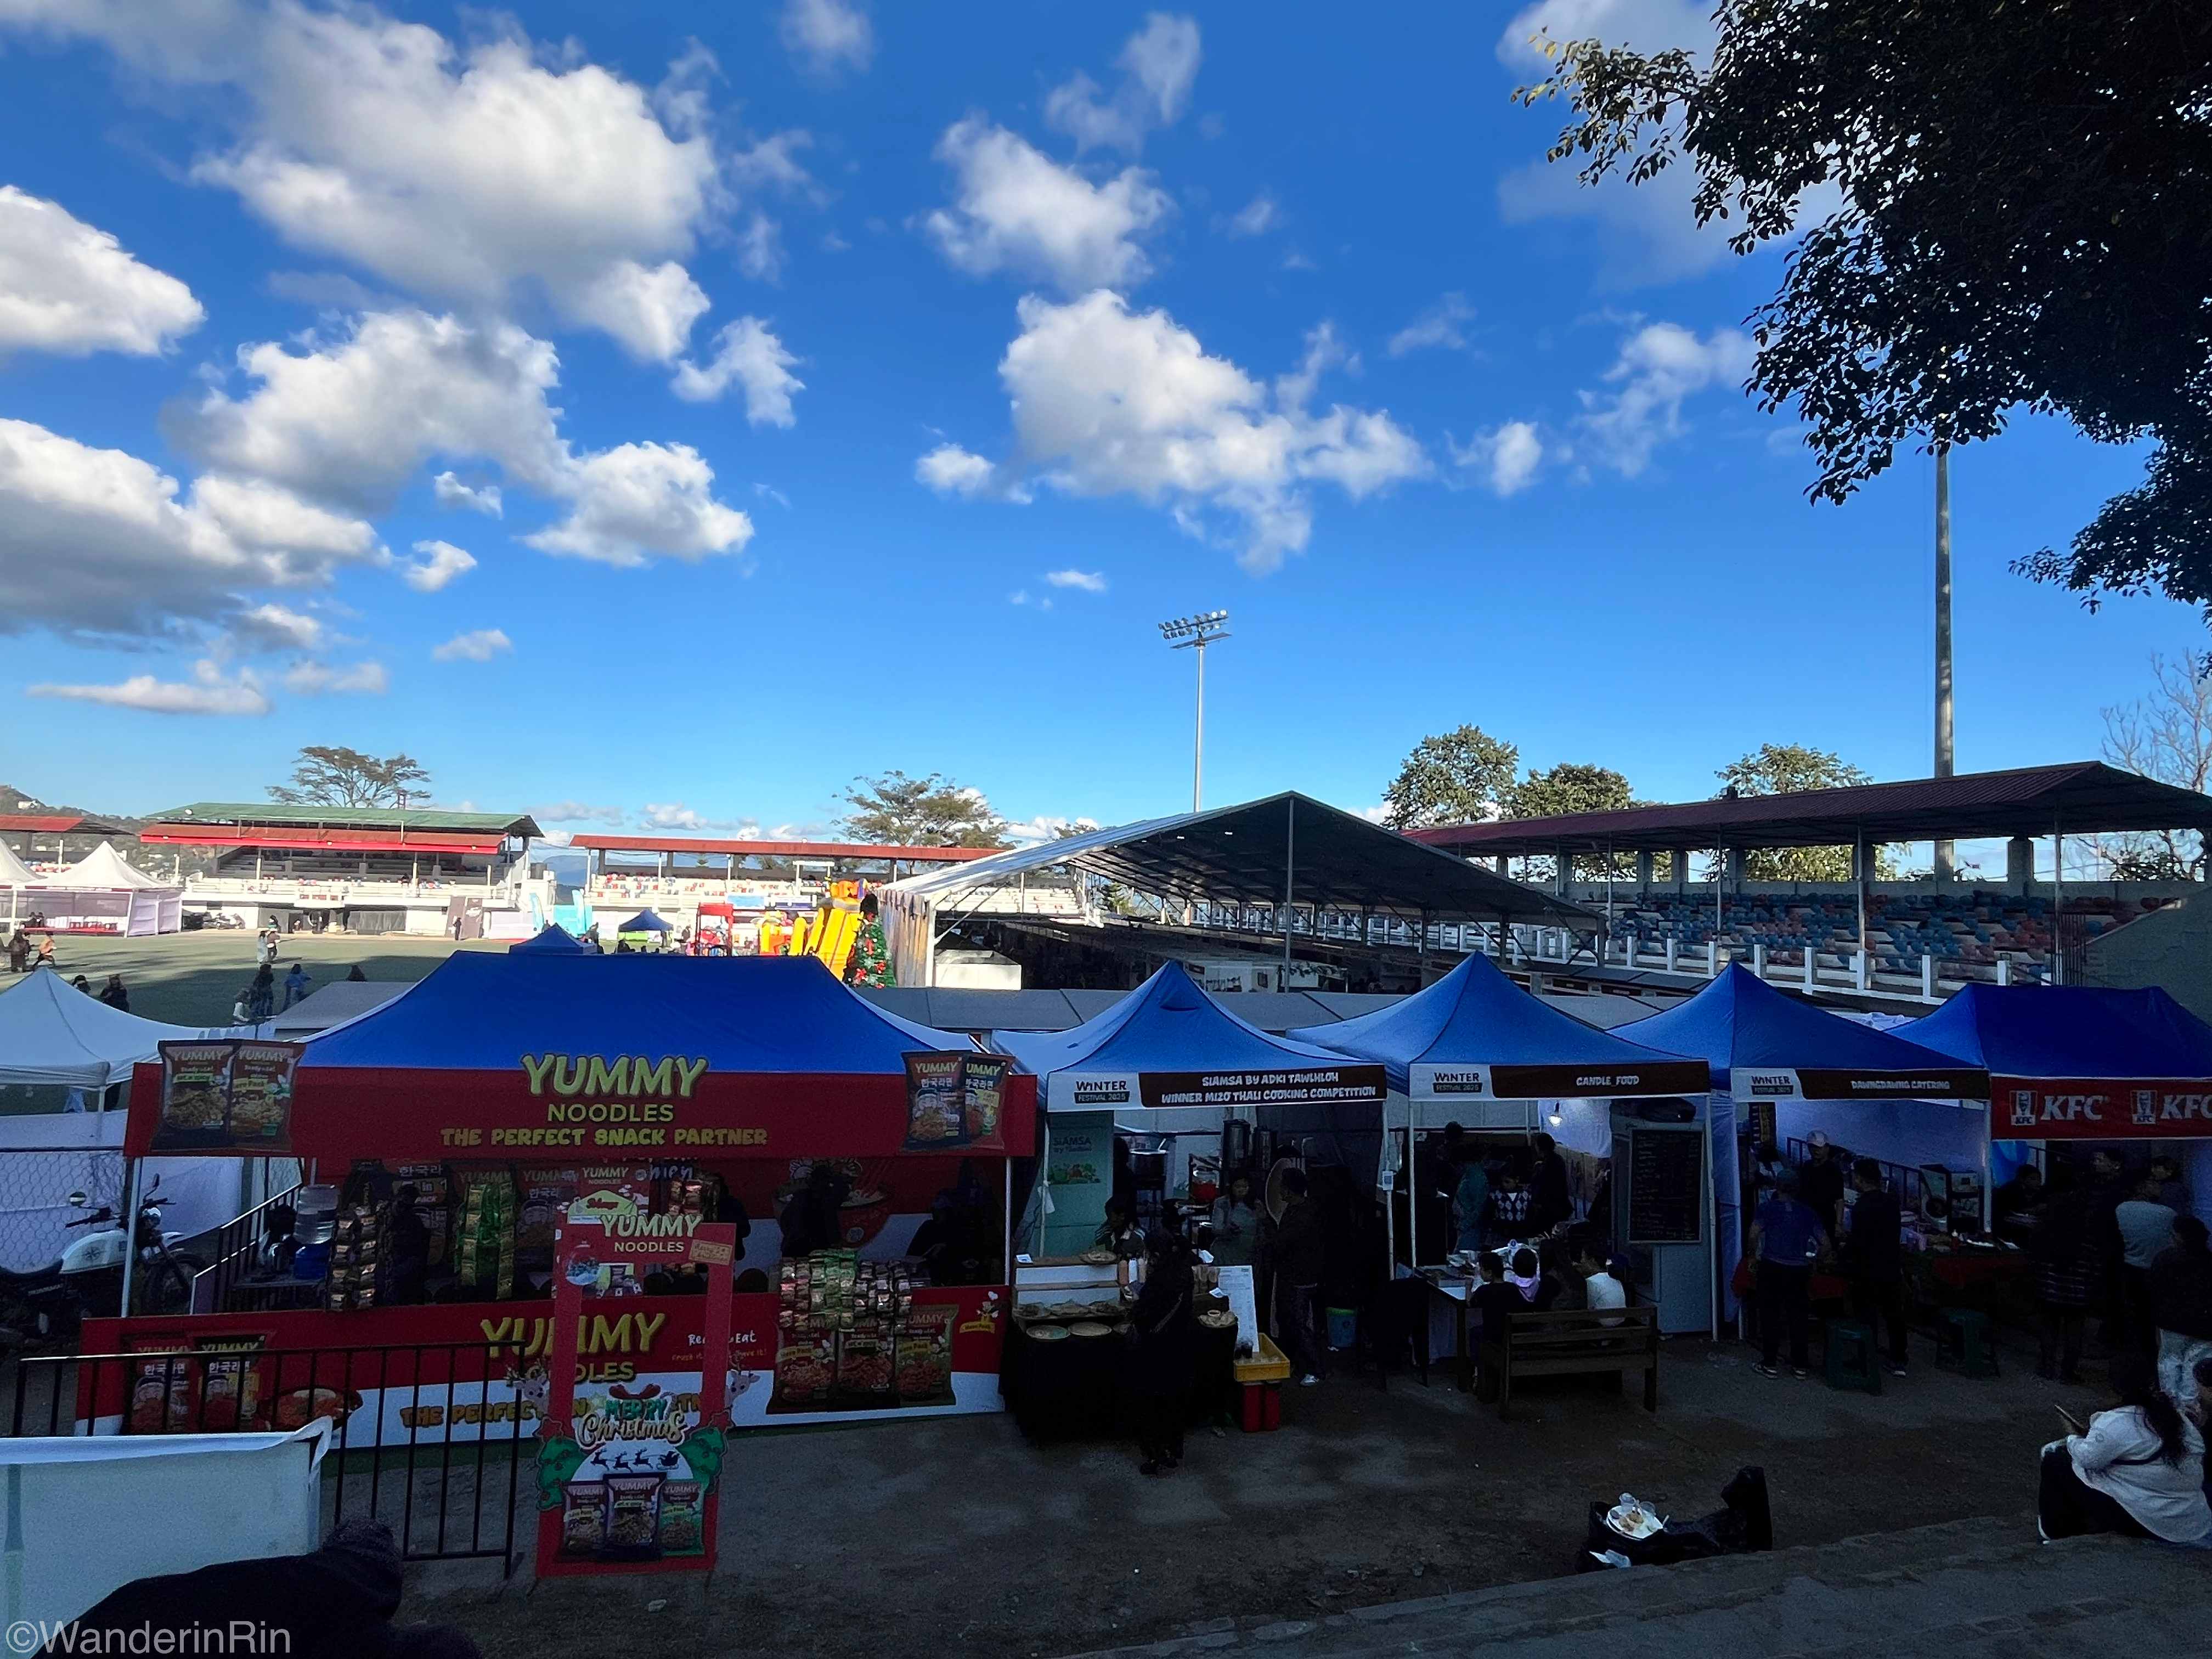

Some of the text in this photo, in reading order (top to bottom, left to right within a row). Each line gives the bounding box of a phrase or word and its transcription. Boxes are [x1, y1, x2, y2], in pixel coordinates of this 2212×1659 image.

[174, 1050, 224, 1061] YUMMY
[239, 1049, 287, 1062] YUMMY
[521, 1053, 708, 1097] YUMMY
[915, 1062, 958, 1074] YUMMY
[966, 1063, 1001, 1076] UMMY
[1201, 1075, 1243, 1086] SIAMSA
[1245, 1075, 1260, 1085] BY
[1261, 1074, 1286, 1085] ADKI
[1161, 1086, 1376, 1103] WINNER MIZO THALI COOKING COMPETITION
[548, 1103, 674, 1123] NOODLES
[2040, 1094, 2104, 1120] KFC
[2160, 1094, 2212, 1119] KFC
[441, 1128, 768, 1147] THE PERFECT SNACK PARTNER
[399, 1164, 443, 1177] 한국라
[582, 1166, 629, 1178] YUMMY
[600, 1214, 703, 1238] YUMMY
[614, 1241, 685, 1253] NOODLES
[909, 1314, 945, 1324] UMMY
[735, 1330, 757, 1344] Eat
[400, 1406, 444, 1428] THE
[450, 1400, 543, 1425] PERFEC
[605, 1399, 668, 1421] MERRY
[578, 1410, 687, 1447] Christmas
[613, 1481, 653, 1491] YUMMY
